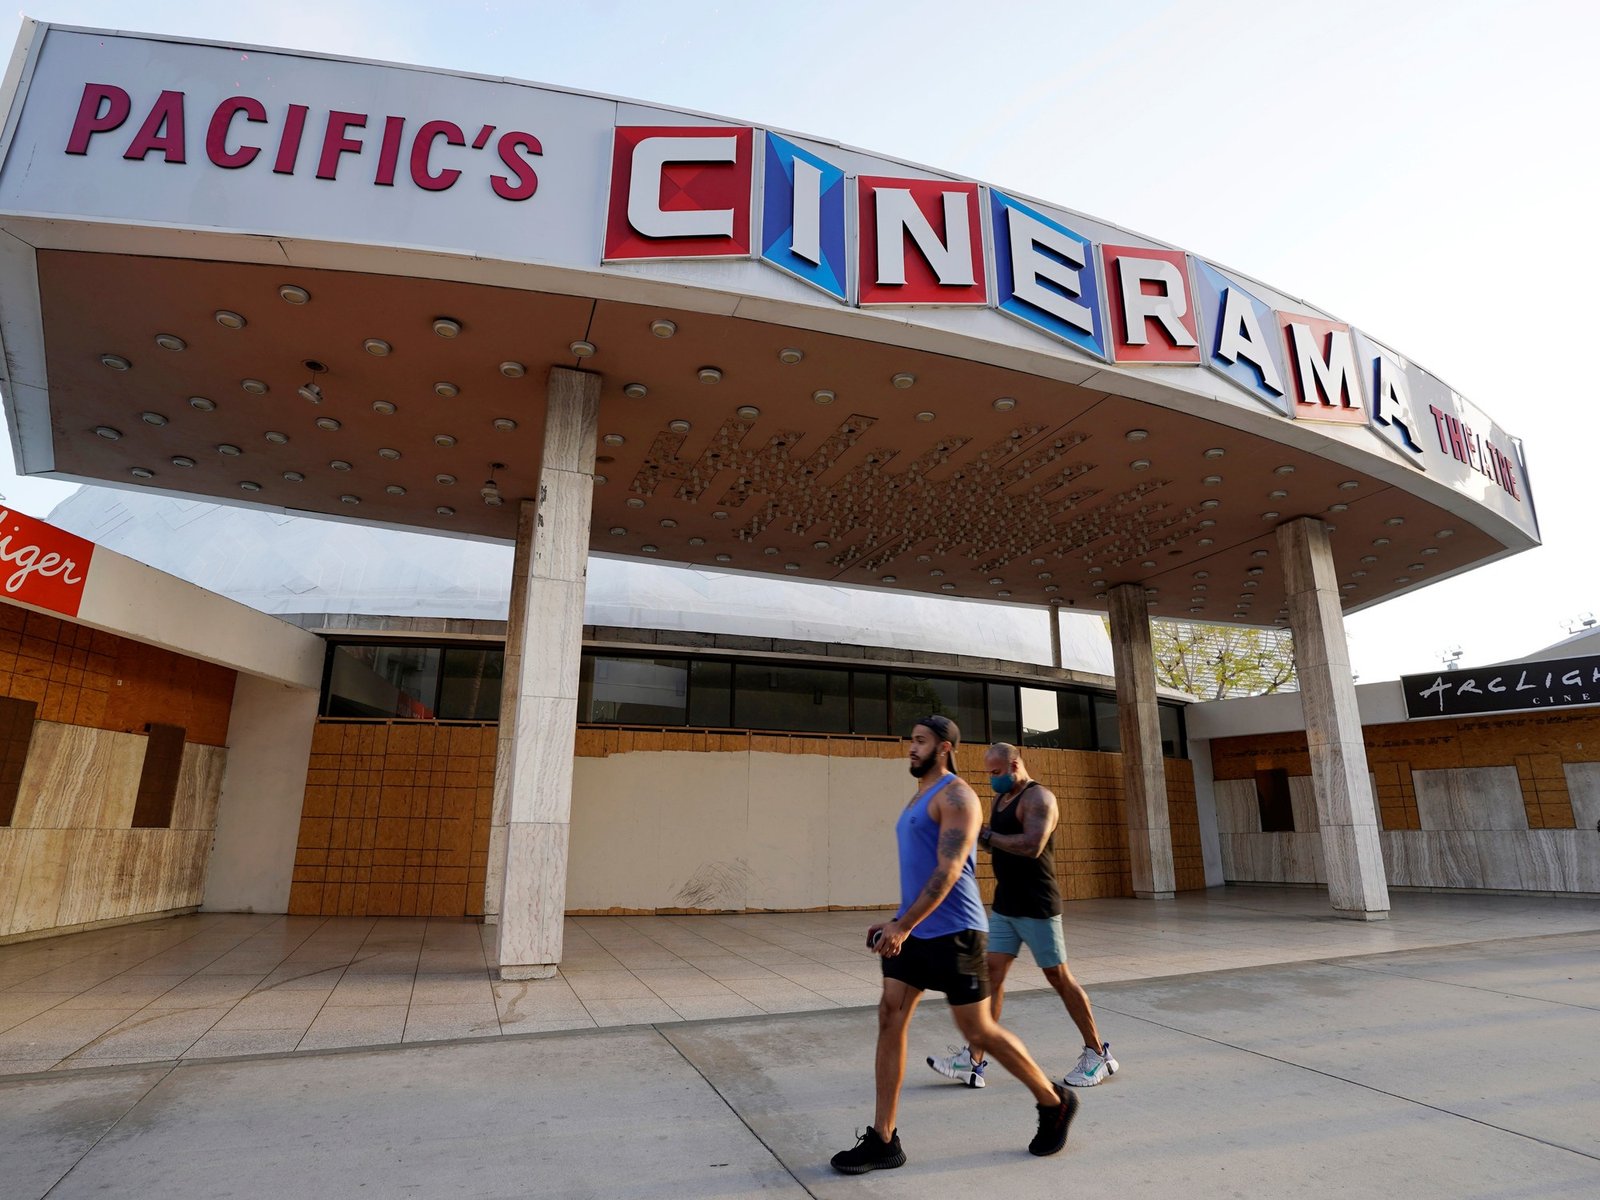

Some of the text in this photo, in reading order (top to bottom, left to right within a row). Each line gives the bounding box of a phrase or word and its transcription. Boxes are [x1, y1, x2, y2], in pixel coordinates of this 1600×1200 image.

[65, 83, 1520, 501] PACIFIC'S CINERAMA THEATRE
[0, 510, 81, 592] iger
